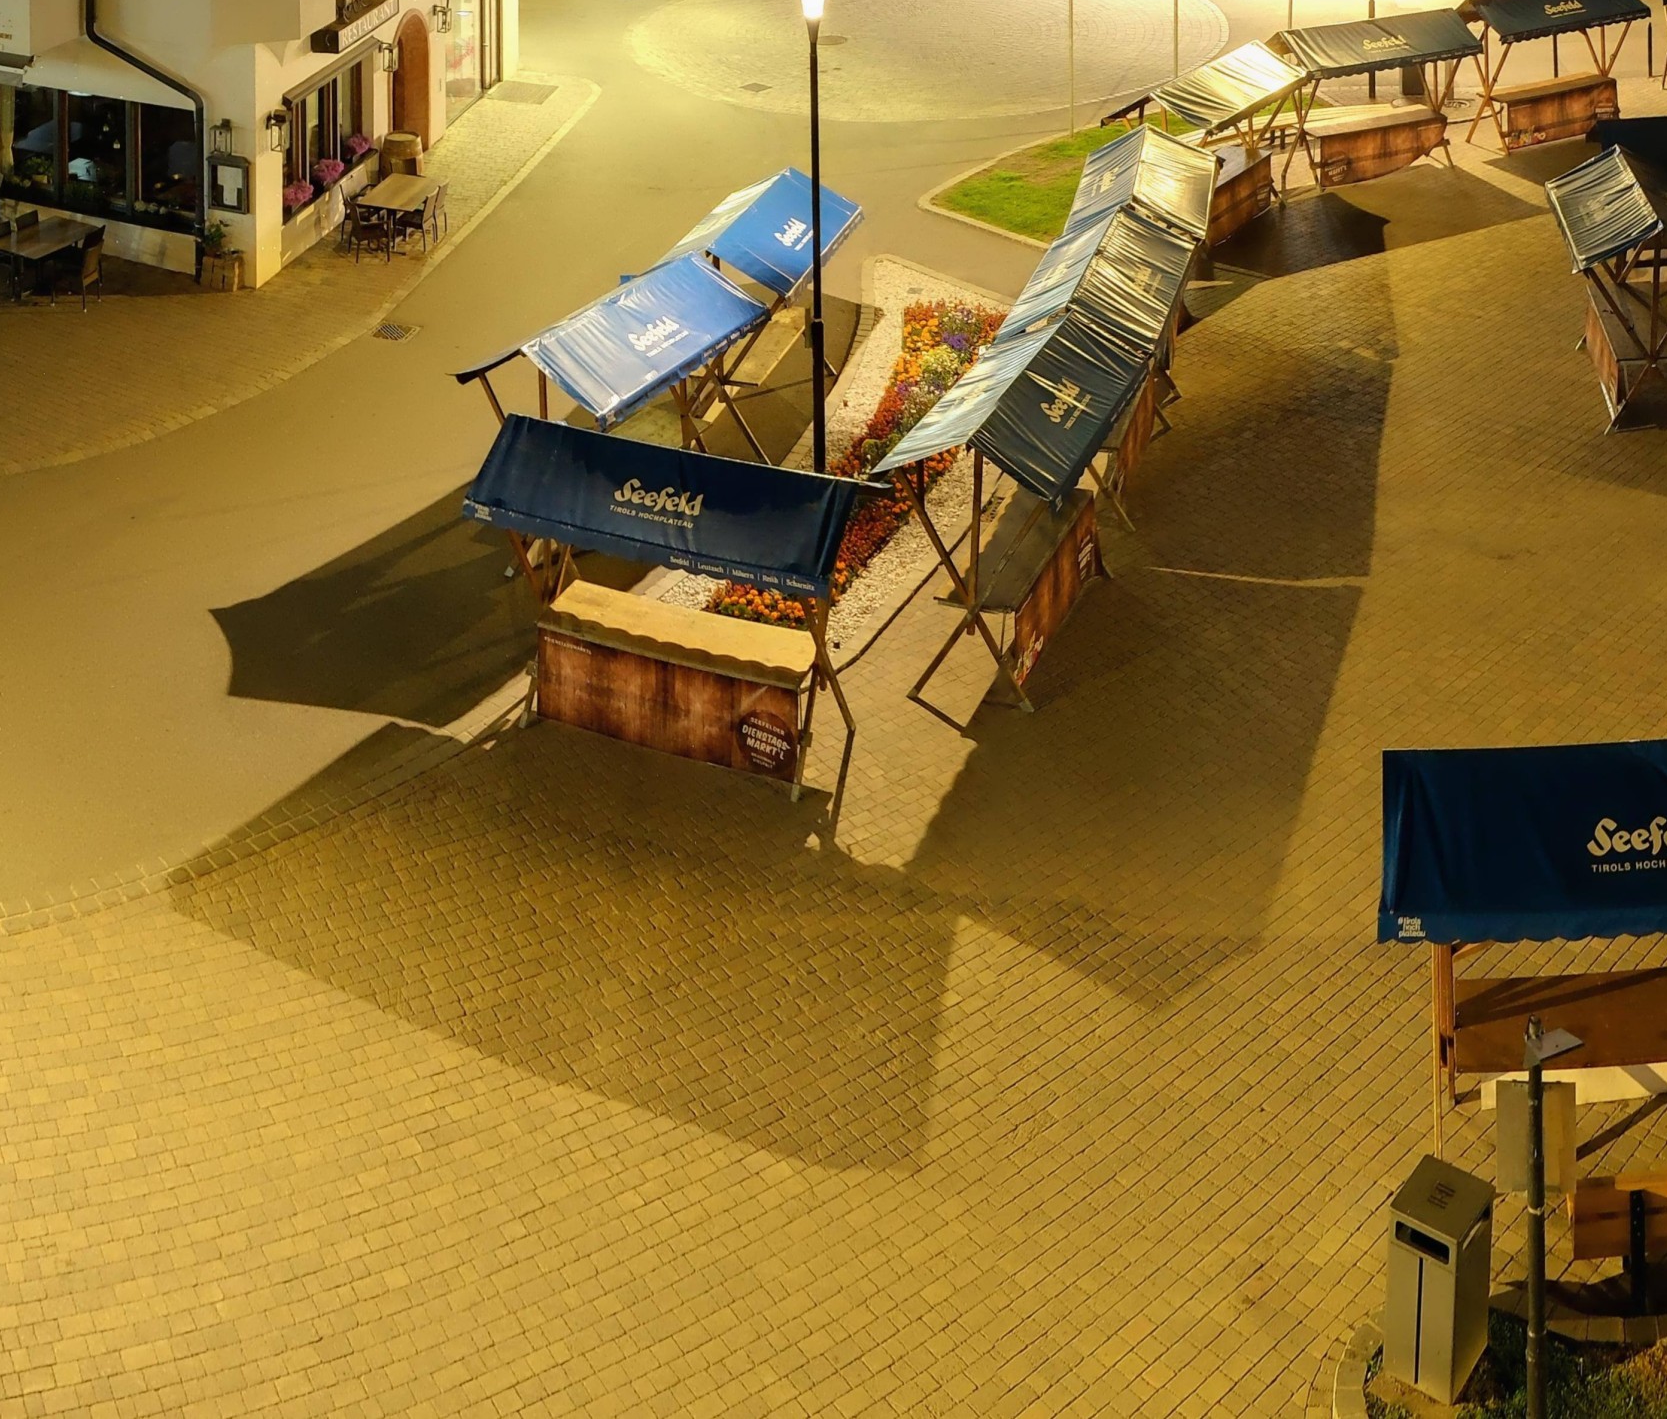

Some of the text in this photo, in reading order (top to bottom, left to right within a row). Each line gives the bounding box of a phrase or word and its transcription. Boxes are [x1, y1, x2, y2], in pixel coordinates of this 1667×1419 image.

[1544, 0, 1583, 15] Seefeld
[1363, 34, 1407, 50] Seefeld
[628, 315, 681, 352] Seefeld
[1040, 377, 1081, 423] Seefeld
[614, 477, 704, 517] Seefeld
[609, 504, 694, 529] TIROLS HOCHPLATEAU
[698, 562, 724, 574] Leutasch
[786, 578, 815, 591] Scharnitz
[742, 724, 791, 750] DIENSTAGS-
[750, 716, 785, 736] SEEFELDER
[746, 737, 785, 760] MARKT'L
[1591, 862, 1632, 873] TIROLS
